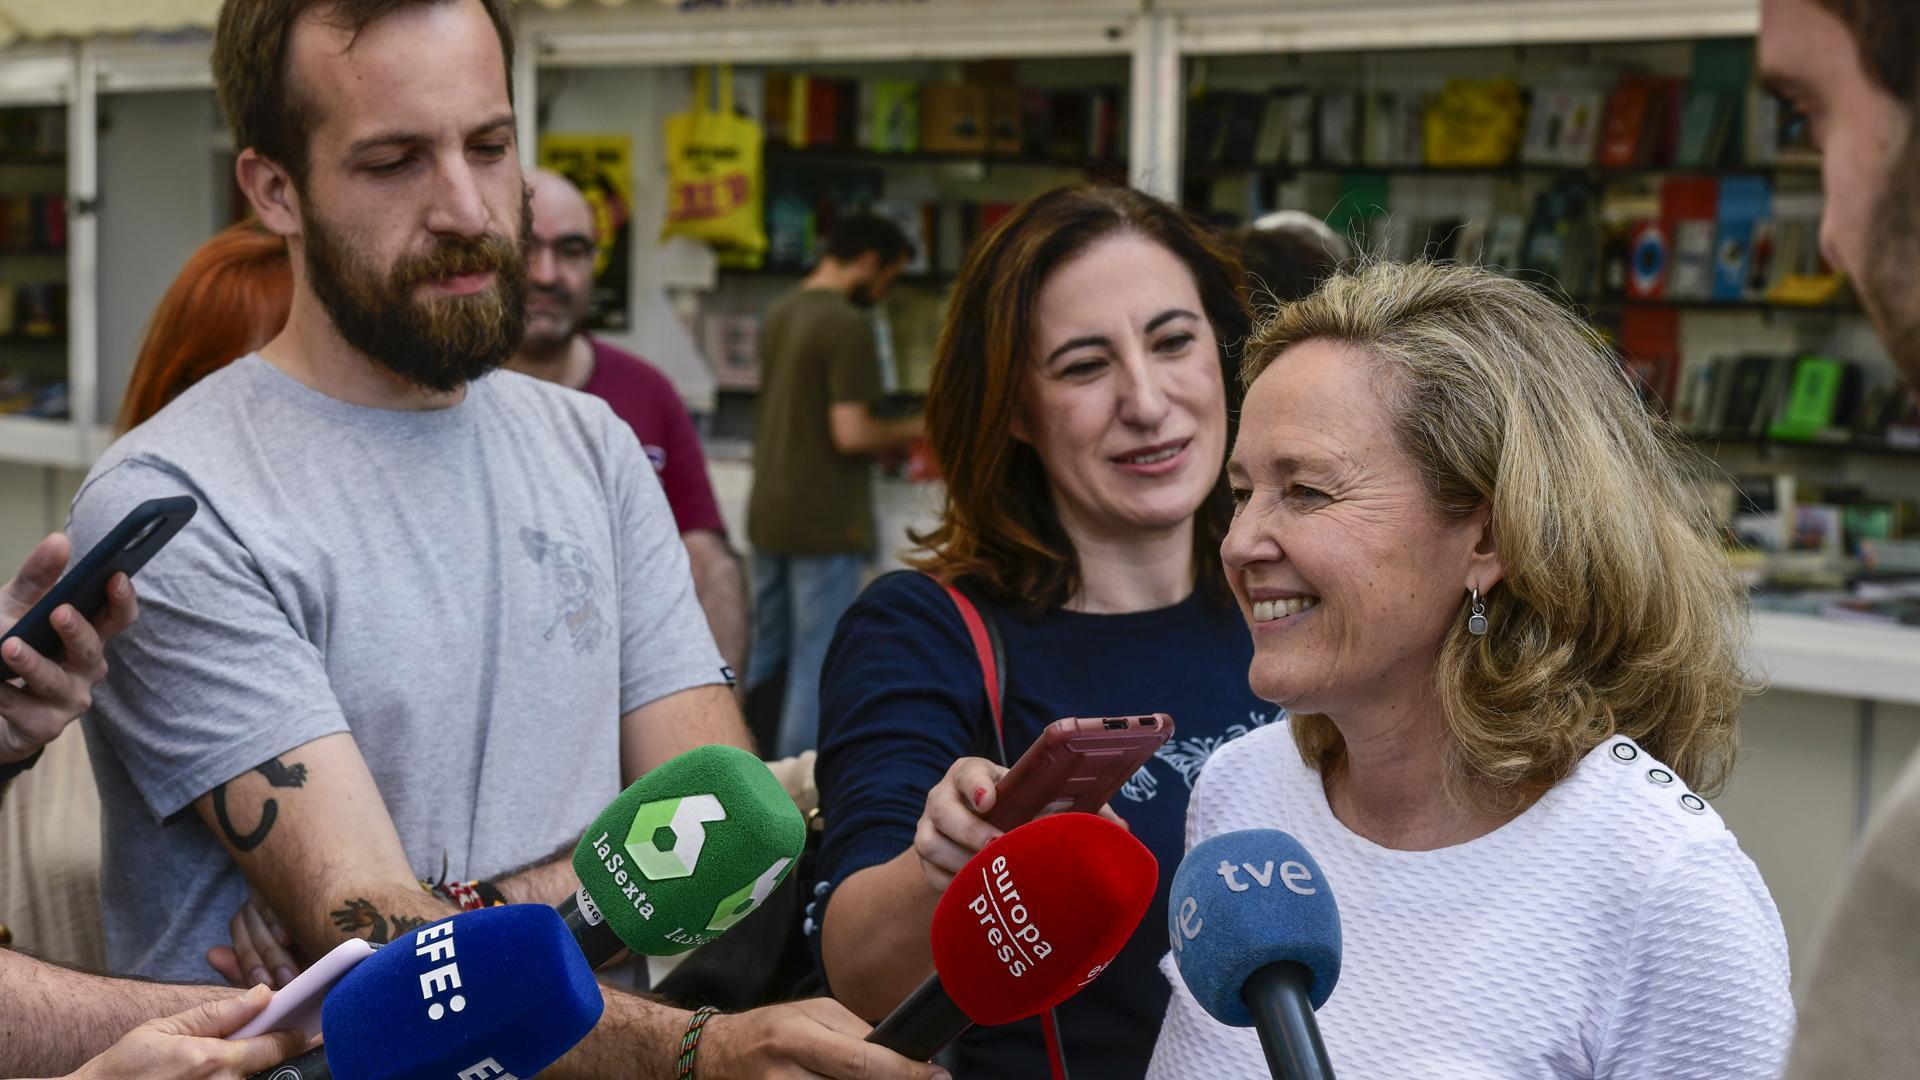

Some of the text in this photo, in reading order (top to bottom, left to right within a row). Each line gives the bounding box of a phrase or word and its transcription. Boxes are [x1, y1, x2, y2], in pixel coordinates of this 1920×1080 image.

[581, 889, 601, 920] 6746
[592, 832, 655, 920] laSexta
[991, 855, 1053, 960] europa
[1216, 859, 1317, 896] tve
[415, 920, 466, 1021] EFE:
[968, 894, 1027, 978] press
